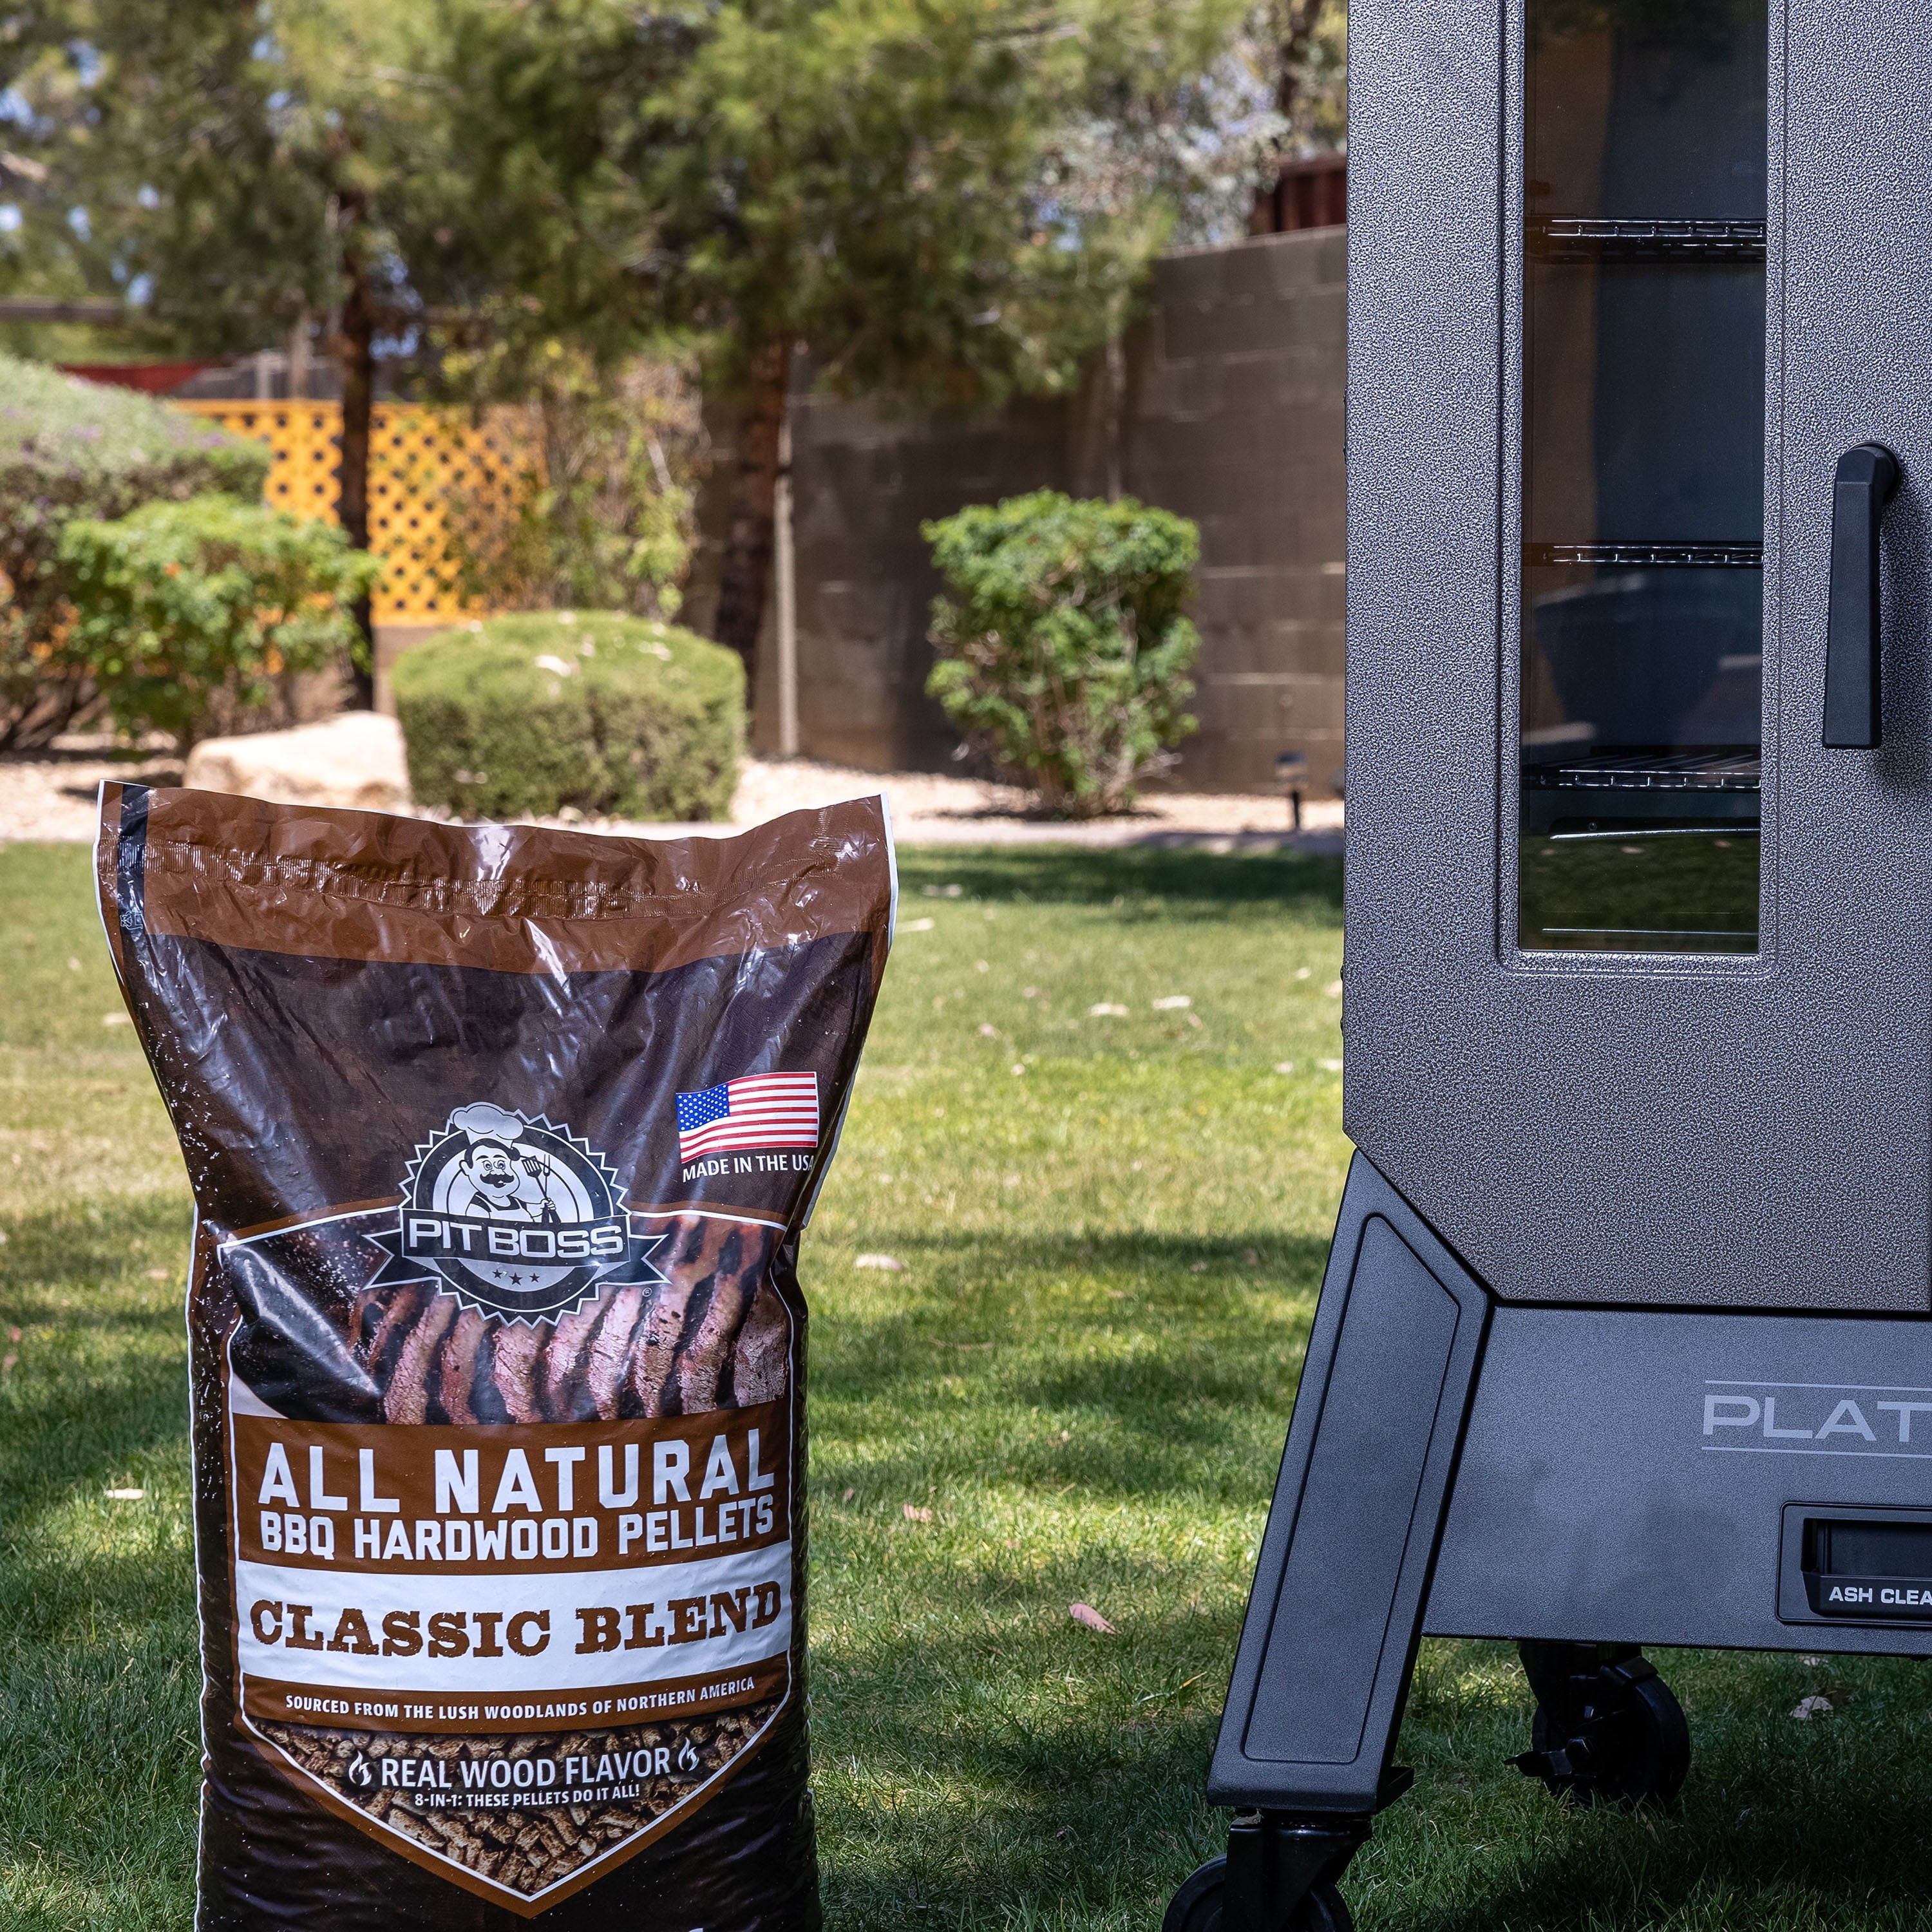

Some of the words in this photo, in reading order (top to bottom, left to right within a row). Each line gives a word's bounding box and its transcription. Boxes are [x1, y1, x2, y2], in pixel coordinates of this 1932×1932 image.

[683, 1158, 730, 1183] MADE
[734, 1157, 752, 1173] IN
[755, 1155, 788, 1171] THE
[793, 1155, 814, 1171] USA
[409, 1218, 482, 1251] PIT
[489, 1225, 623, 1258] BOSS
[1703, 1395, 1932, 1443] PLAT
[258, 1442, 400, 1513] ALL
[435, 1428, 774, 1513] NATURAL
[260, 1511, 335, 1560] BBQ
[354, 1517, 598, 1560] HARDWOOD
[619, 1493, 773, 1555] PELLETS
[1829, 1586, 1873, 1603] ASH
[250, 1599, 551, 1658] CLASSIC
[575, 1580, 781, 1654] BLEND
[286, 1695, 349, 1714] SOURCED
[354, 1702, 399, 1718] FROM
[404, 1705, 433, 1719] THE
[439, 1705, 479, 1719] LUSH
[484, 1702, 587, 1719] WOODLANDS
[592, 1700, 612, 1714] OF
[617, 1689, 696, 1712] NORTHERN
[699, 1676, 755, 1701] AMERICA
[382, 1758, 452, 1788] REAL
[460, 1759, 556, 1788] WOOD
[566, 1747, 671, 1785] FLAVOR
[415, 1794, 462, 1807] 8-IN-1:
[466, 1794, 509, 1807] THESE
[513, 1790, 569, 1806] PELLETS
[573, 1789, 592, 1803] DO
[596, 1787, 609, 1801] IT
[612, 1784, 639, 1799] ALL!
